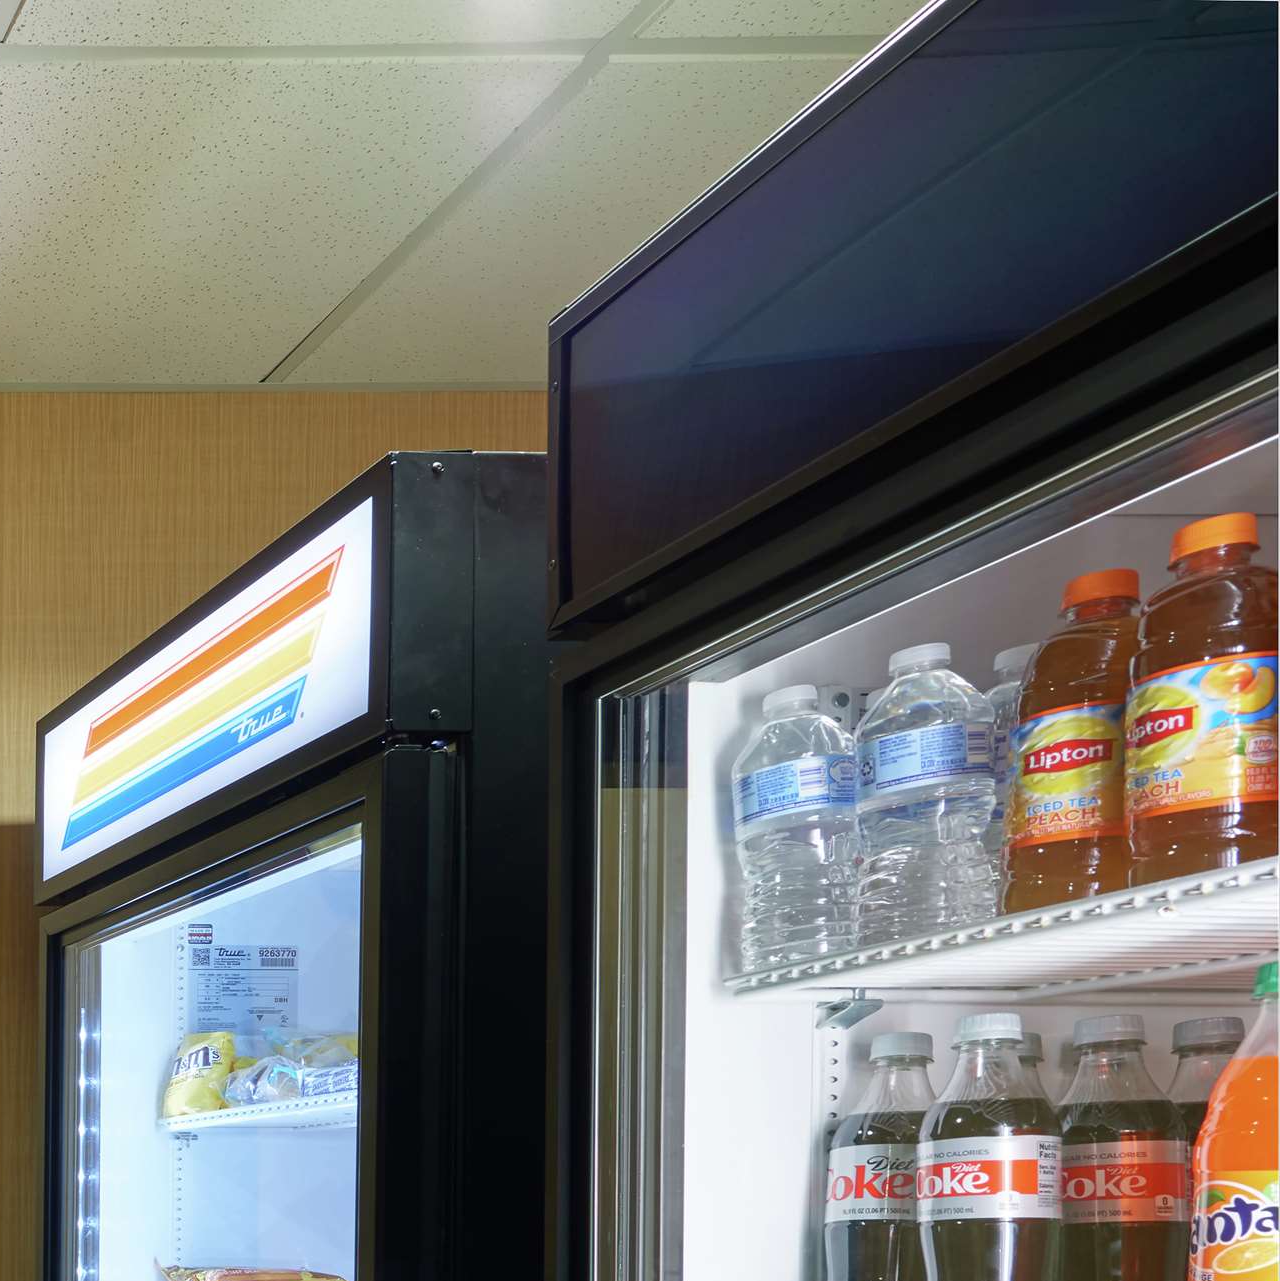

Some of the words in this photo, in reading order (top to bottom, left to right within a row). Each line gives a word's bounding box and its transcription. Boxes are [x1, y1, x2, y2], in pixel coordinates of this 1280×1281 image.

[231, 705, 290, 744] true
[1029, 744, 1104, 769] Lipton
[1153, 769, 1182, 783] TEA
[1027, 800, 1064, 817] ICED
[1069, 796, 1100, 809] TEA
[1027, 807, 1096, 830] PEACH
[258, 949, 297, 958] 9263770
[946, 1149, 990, 1159] CALORIES
[1099, 1151, 1148, 1160] CALORIES
[867, 1155, 915, 1172] Diet
[952, 1162, 982, 1173] Diet
[1106, 1166, 1139, 1175] Diet
[1161, 1196, 1169, 1206] 0
[953, 1207, 964, 1215] 500
[1192, 1196, 1280, 1255] anta
